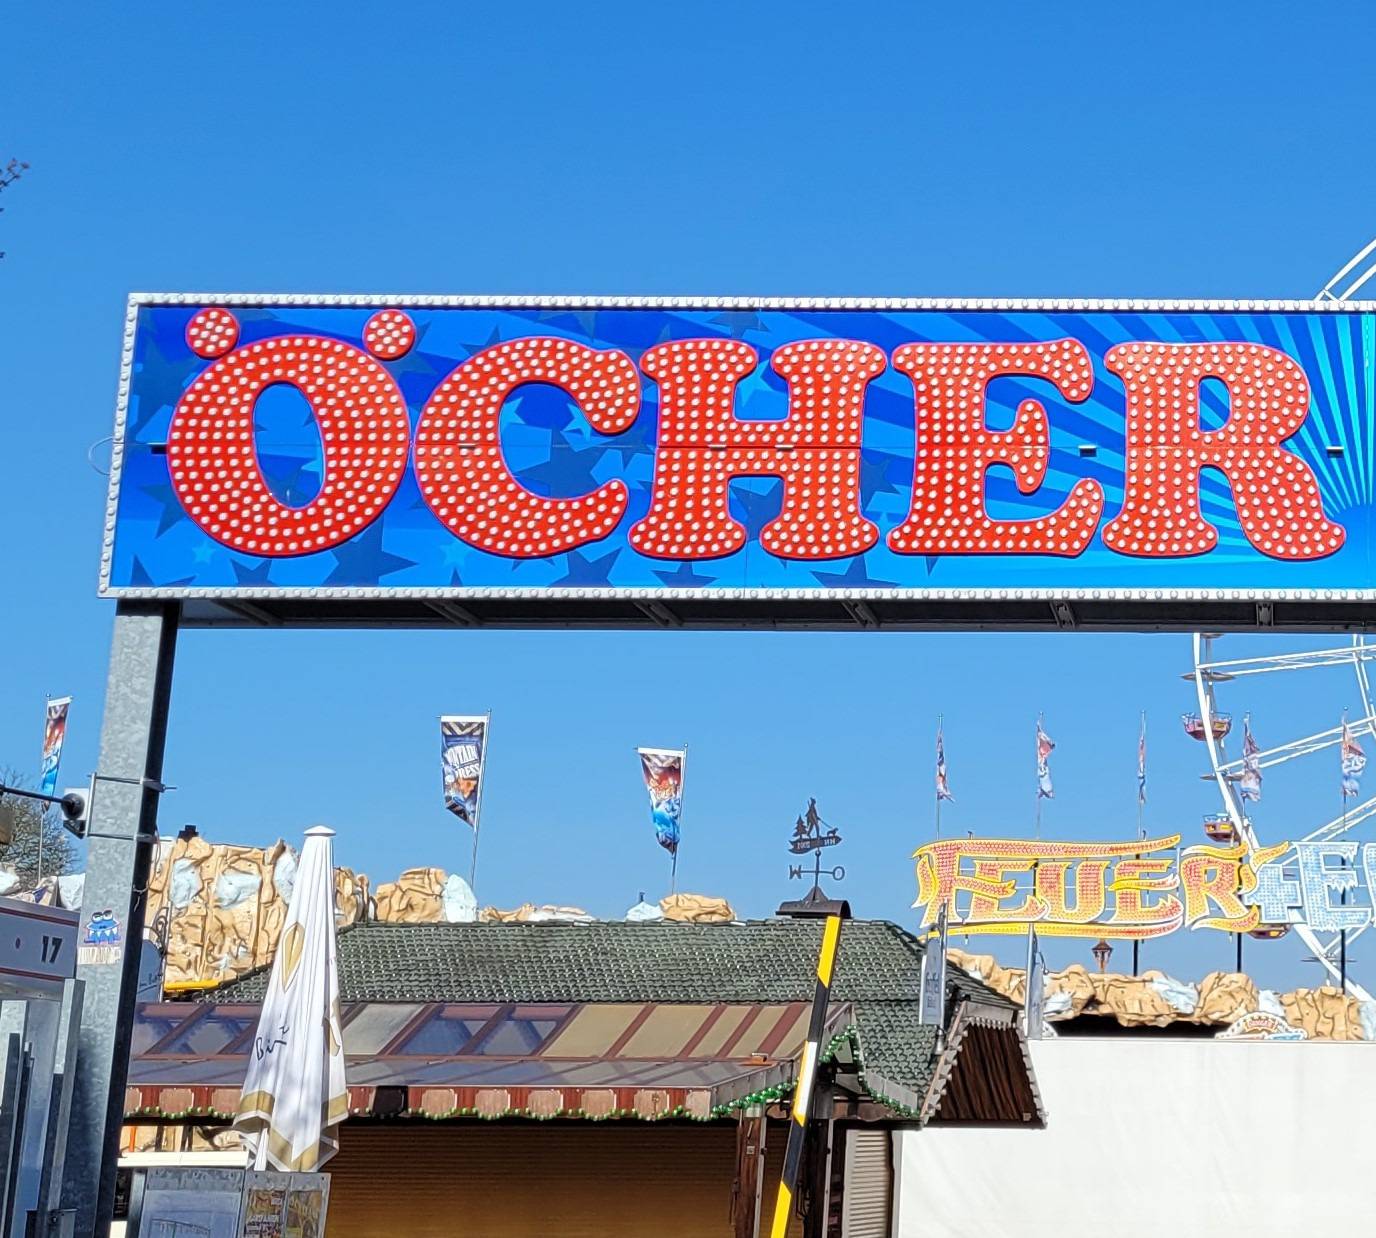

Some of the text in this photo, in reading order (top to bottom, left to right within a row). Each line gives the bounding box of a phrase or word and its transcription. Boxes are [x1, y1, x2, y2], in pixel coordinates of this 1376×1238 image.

[165, 307, 1347, 560] ÖCHER
[913, 834, 1262, 938] FEUER
[41, 935, 63, 964] 17
